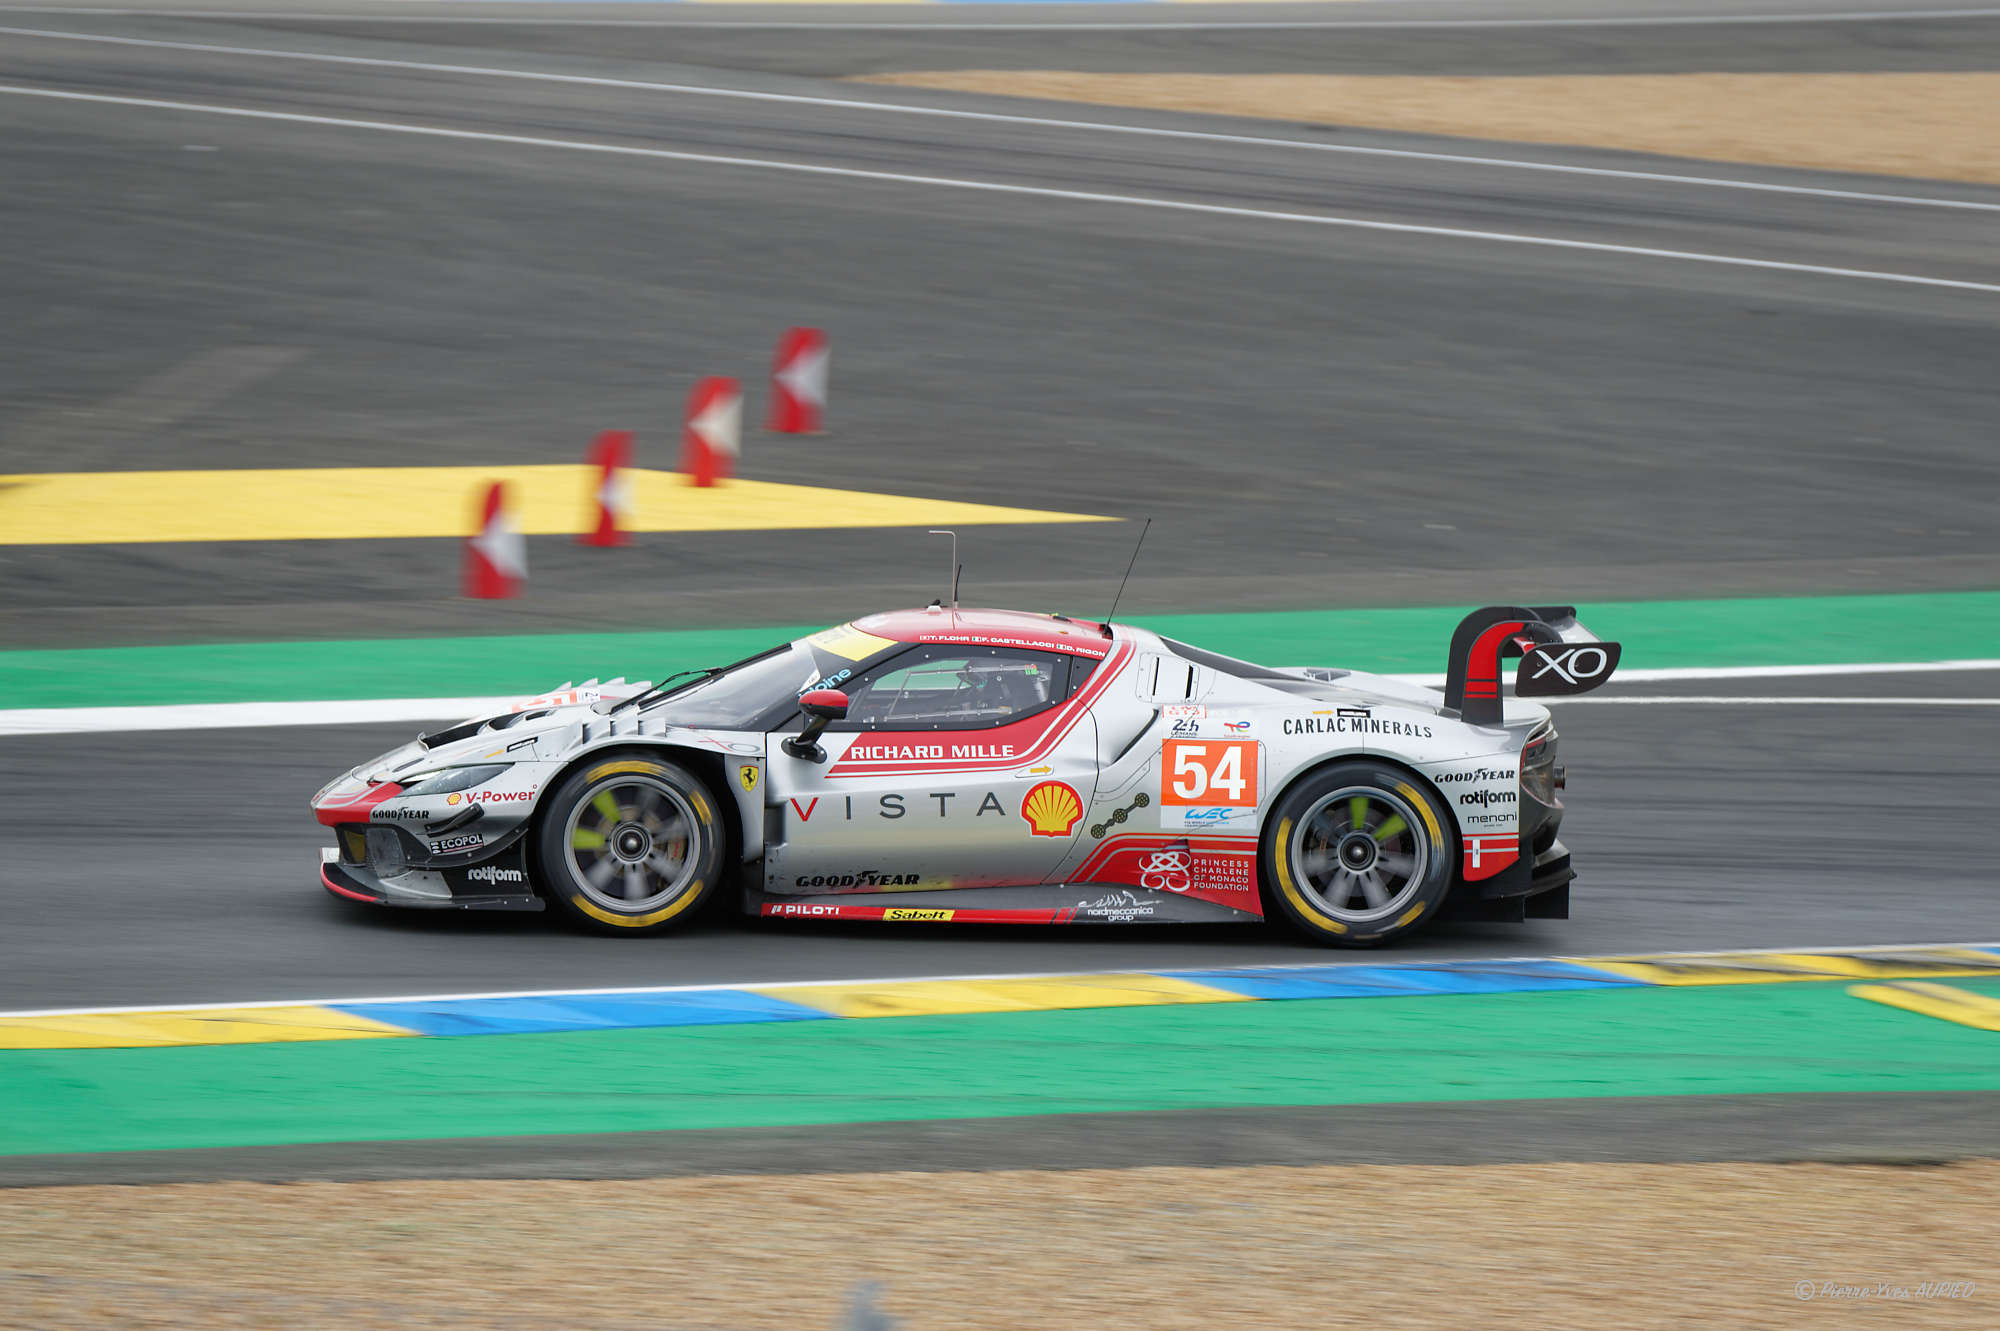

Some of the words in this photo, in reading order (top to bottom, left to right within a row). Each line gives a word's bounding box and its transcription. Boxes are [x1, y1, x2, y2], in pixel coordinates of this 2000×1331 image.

[991, 637, 1054, 649] CASTELLACCI
[1076, 647, 1106, 658] RIGON
[1532, 648, 1607, 685] XO
[1283, 717, 1346, 735] CARLAC
[1351, 717, 1433, 738] MINERALS
[851, 745, 943, 760] RICHARD
[951, 744, 1014, 758] MILLE
[1172, 744, 1246, 800] 54
[1434, 768, 1515, 783] GOODYEAR
[466, 791, 535, 804] V-Power
[1460, 789, 1517, 808] rotiform
[372, 806, 430, 820] GOODYEAR
[790, 792, 1006, 822] VISTA
[1467, 812, 1517, 823] menoni
[441, 835, 482, 849] ECOPOL
[1193, 858, 1249, 868] PRINCESS
[468, 865, 522, 885] rotiform
[1193, 866, 1249, 876] CHARLENE
[796, 870, 920, 888] GOODYEAR
[1209, 875, 1249, 883] MONACO
[1193, 882, 1249, 892] FOUNDATION
[786, 905, 839, 915] PILOTI
[890, 910, 947, 920] Sabelt
[1087, 906, 1154, 916] nordmeccanica
[1108, 914, 1134, 922] group
